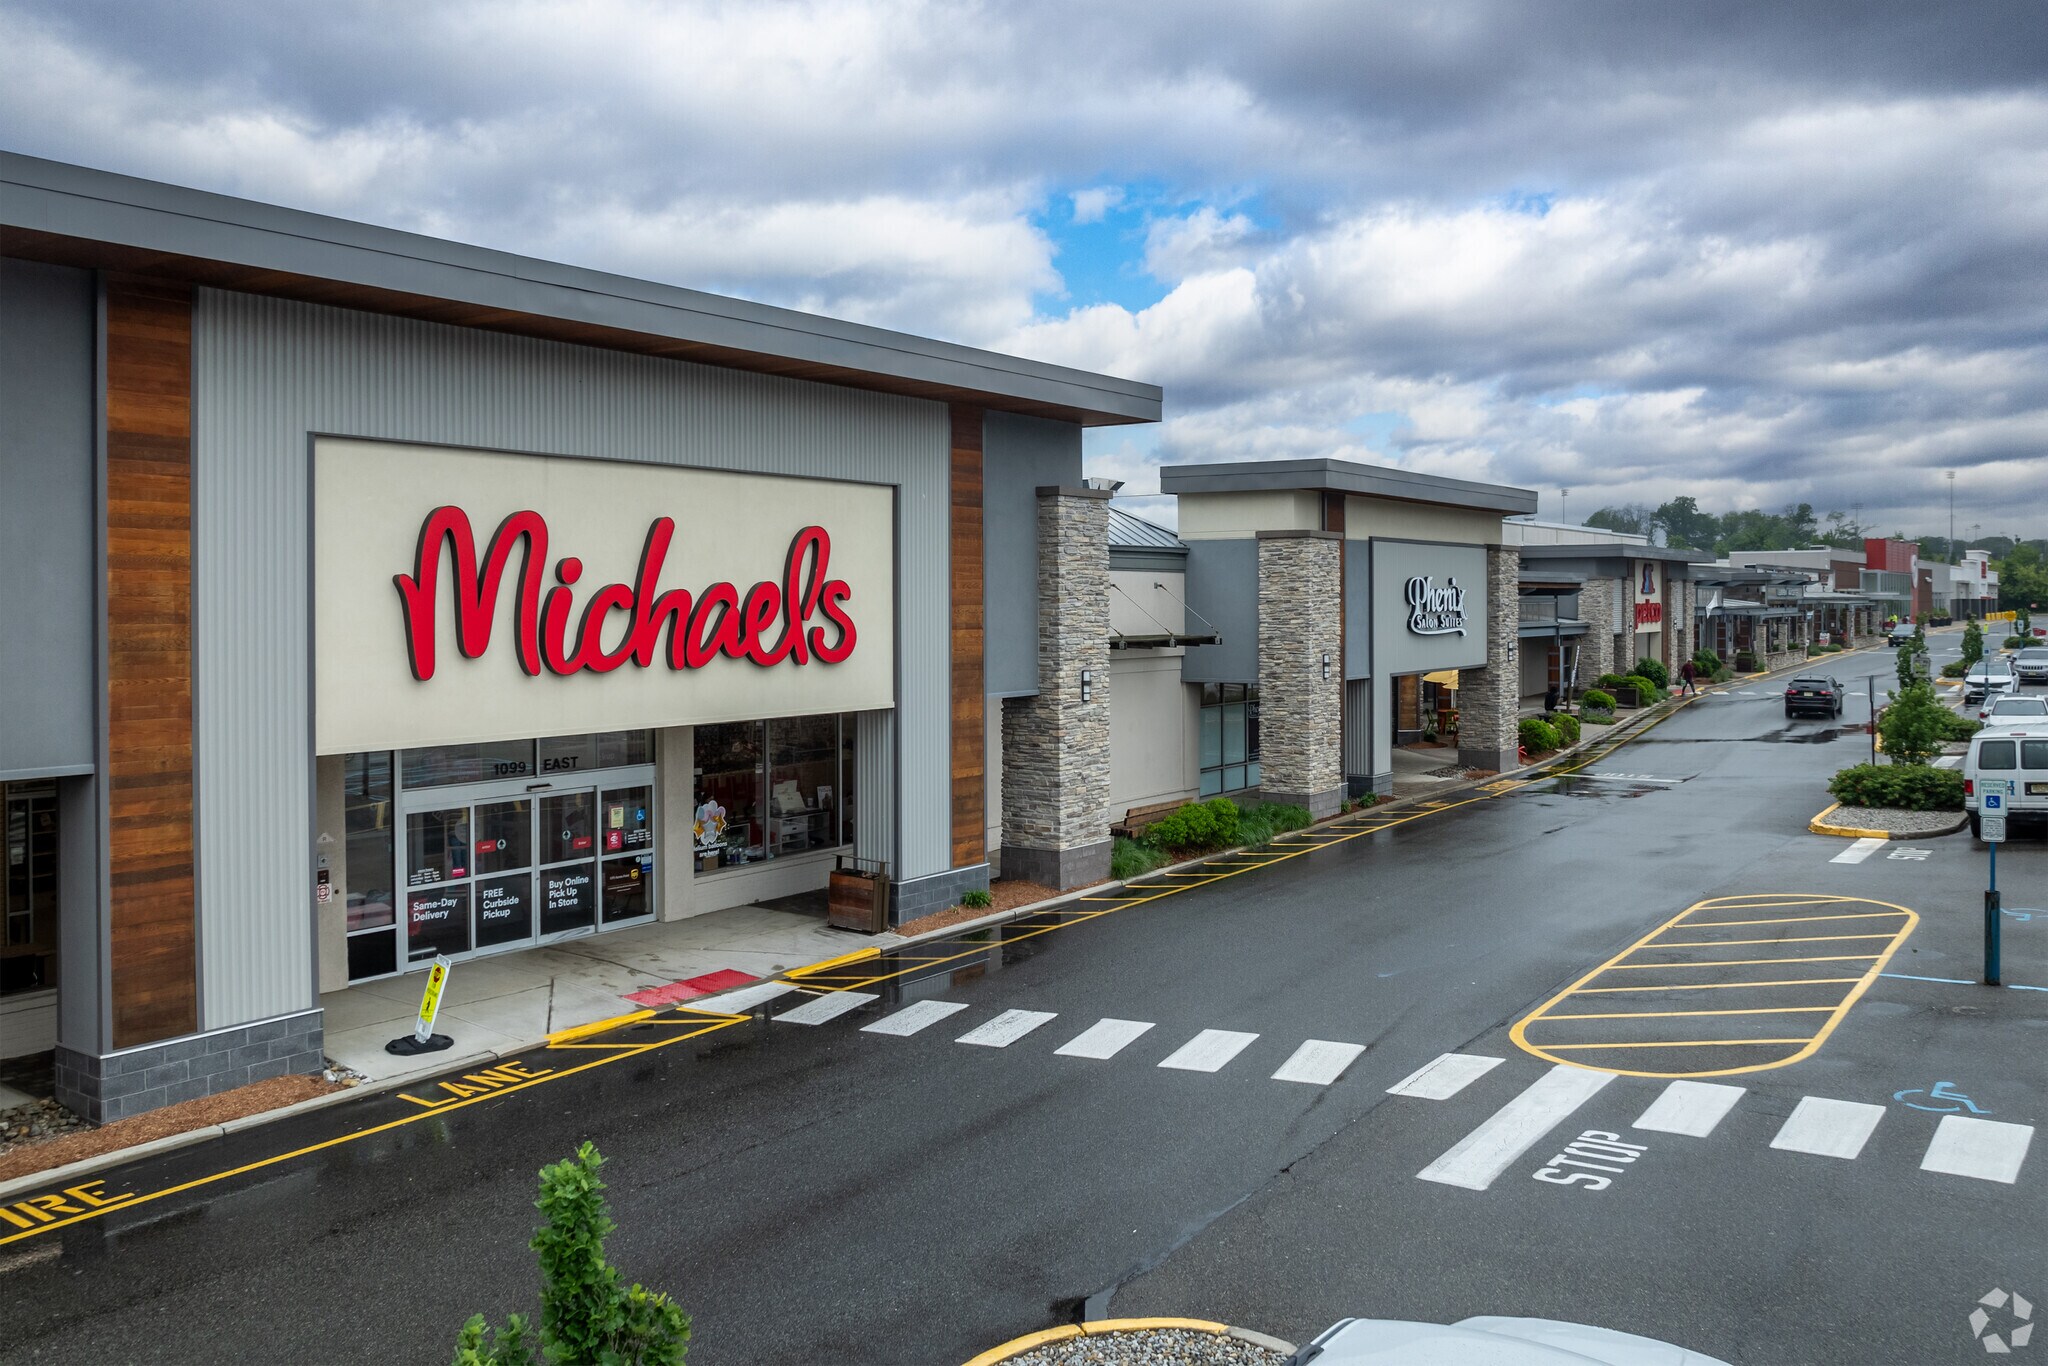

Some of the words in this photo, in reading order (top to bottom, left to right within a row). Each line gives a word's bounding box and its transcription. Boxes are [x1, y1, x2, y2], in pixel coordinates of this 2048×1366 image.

[393, 505, 857, 681] Michaels
[1405, 576, 1468, 620] Phenix
[1635, 599, 1662, 630] petco
[494, 762, 526, 775] 1099
[544, 756, 578, 770] EAST
[549, 880, 563, 889] Buy
[565, 876, 589, 886] Online
[483, 888, 504, 899] FREE
[549, 888, 565, 899] Pick
[566, 887, 578, 897] Up
[413, 898, 458, 911] Same-Day
[483, 896, 520, 909] Curbside
[549, 900, 557, 909] In
[558, 898, 578, 908] Store
[413, 910, 449, 922] Delivery
[483, 908, 511, 920] Pickup
[396, 1060, 554, 1108] LANE
[1532, 1130, 1648, 1190] STOP
